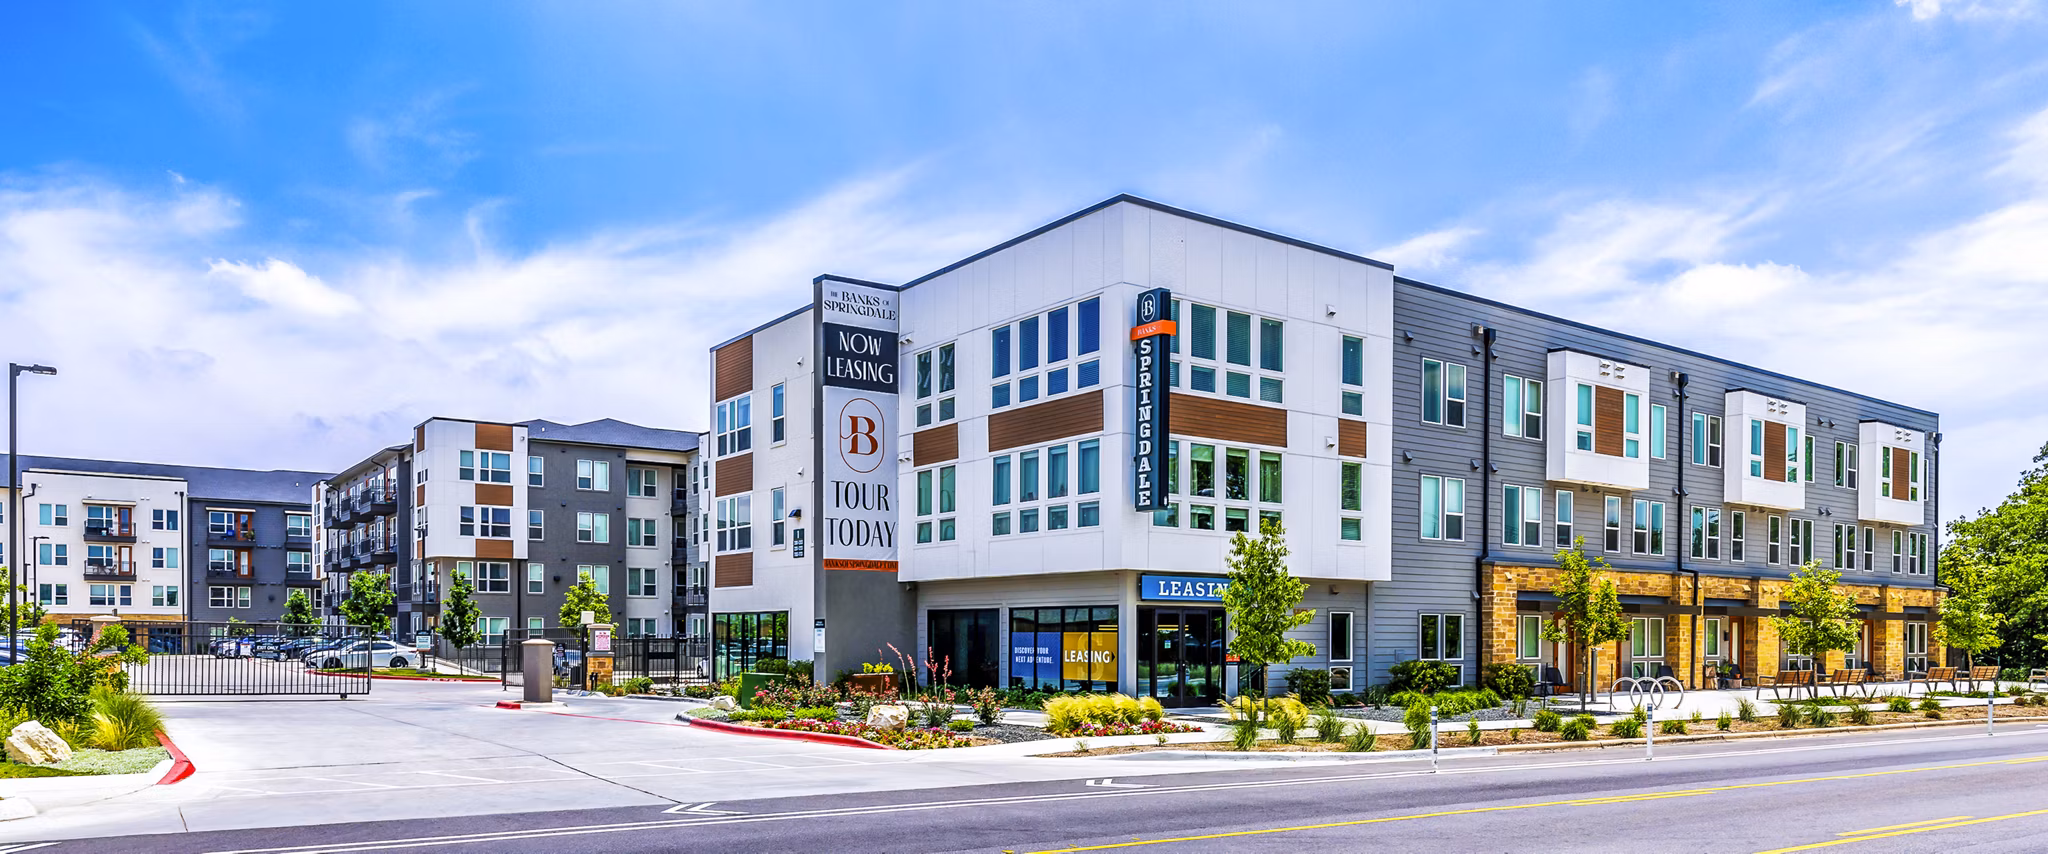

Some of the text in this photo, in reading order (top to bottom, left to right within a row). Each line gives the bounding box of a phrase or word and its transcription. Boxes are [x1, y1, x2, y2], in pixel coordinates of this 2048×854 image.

[823, 299, 897, 321] SPRINGDALE
[841, 290, 881, 307] BANKS
[1143, 299, 1154, 317] B
[839, 330, 882, 356] NOW
[827, 356, 894, 385] LEASING
[847, 414, 879, 456] B
[1138, 338, 1152, 507] SPRINGDALE
[830, 480, 890, 512] TOUR
[825, 517, 897, 548] TODAY
[1158, 580, 1229, 598] LEASIN
[1064, 650, 1110, 663] LEASING
